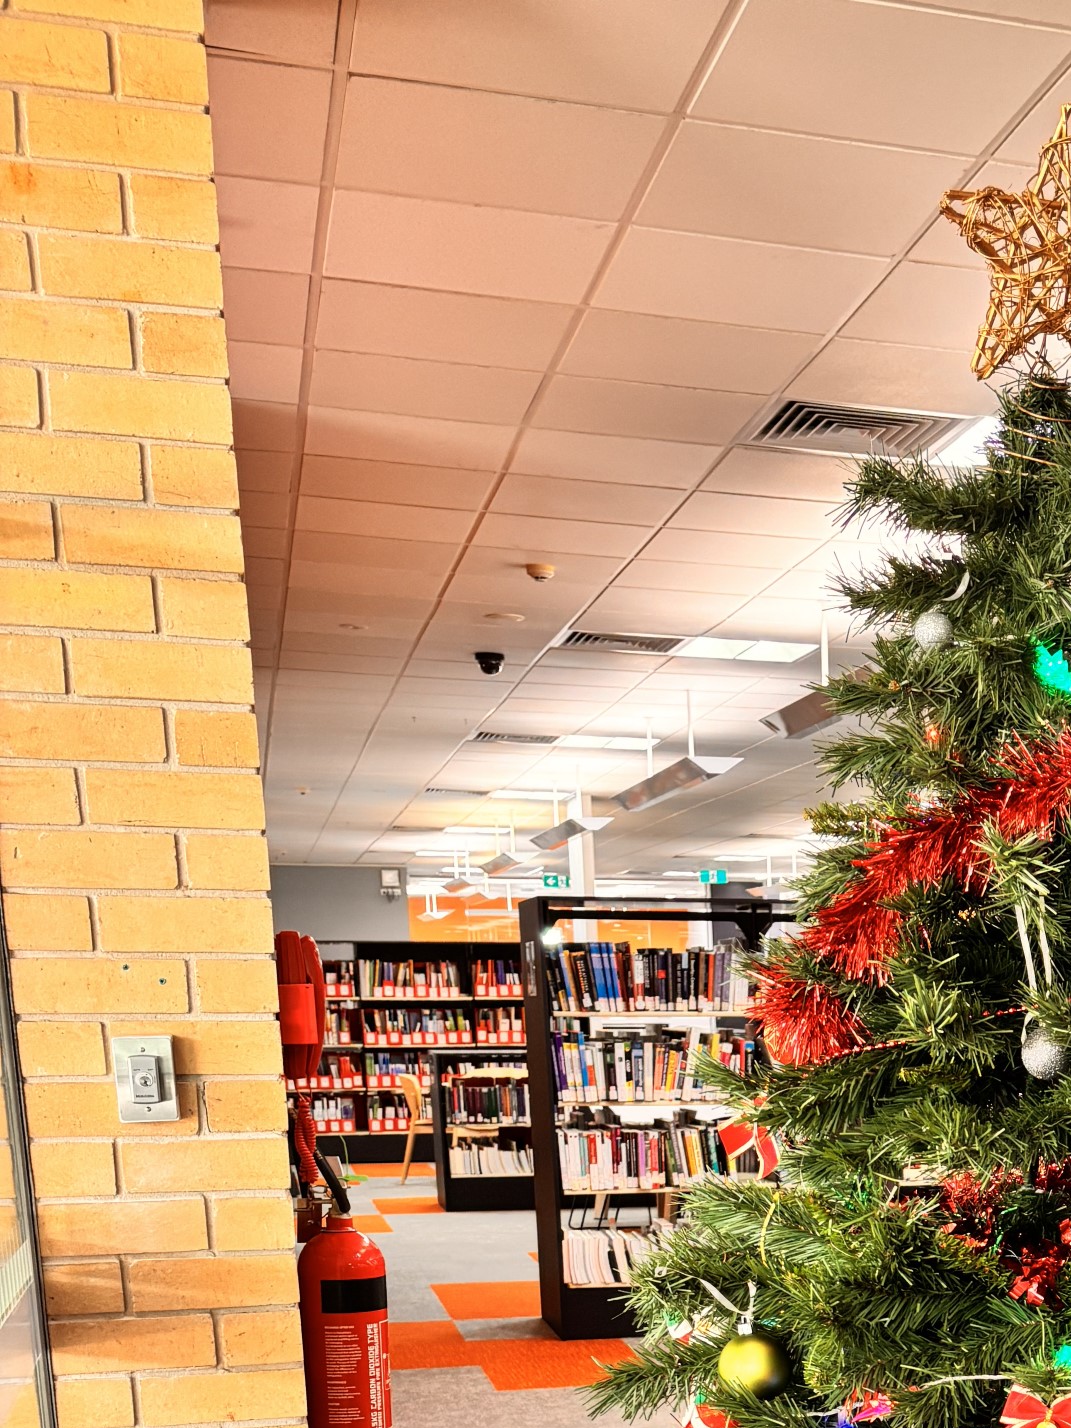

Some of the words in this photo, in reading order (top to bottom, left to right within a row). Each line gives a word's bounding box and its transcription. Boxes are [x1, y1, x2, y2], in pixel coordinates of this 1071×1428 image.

[366, 1323, 375, 1345] TYPE
[368, 1345, 376, 1377] DIOXIDE
[369, 1378, 377, 1410] CARBON
